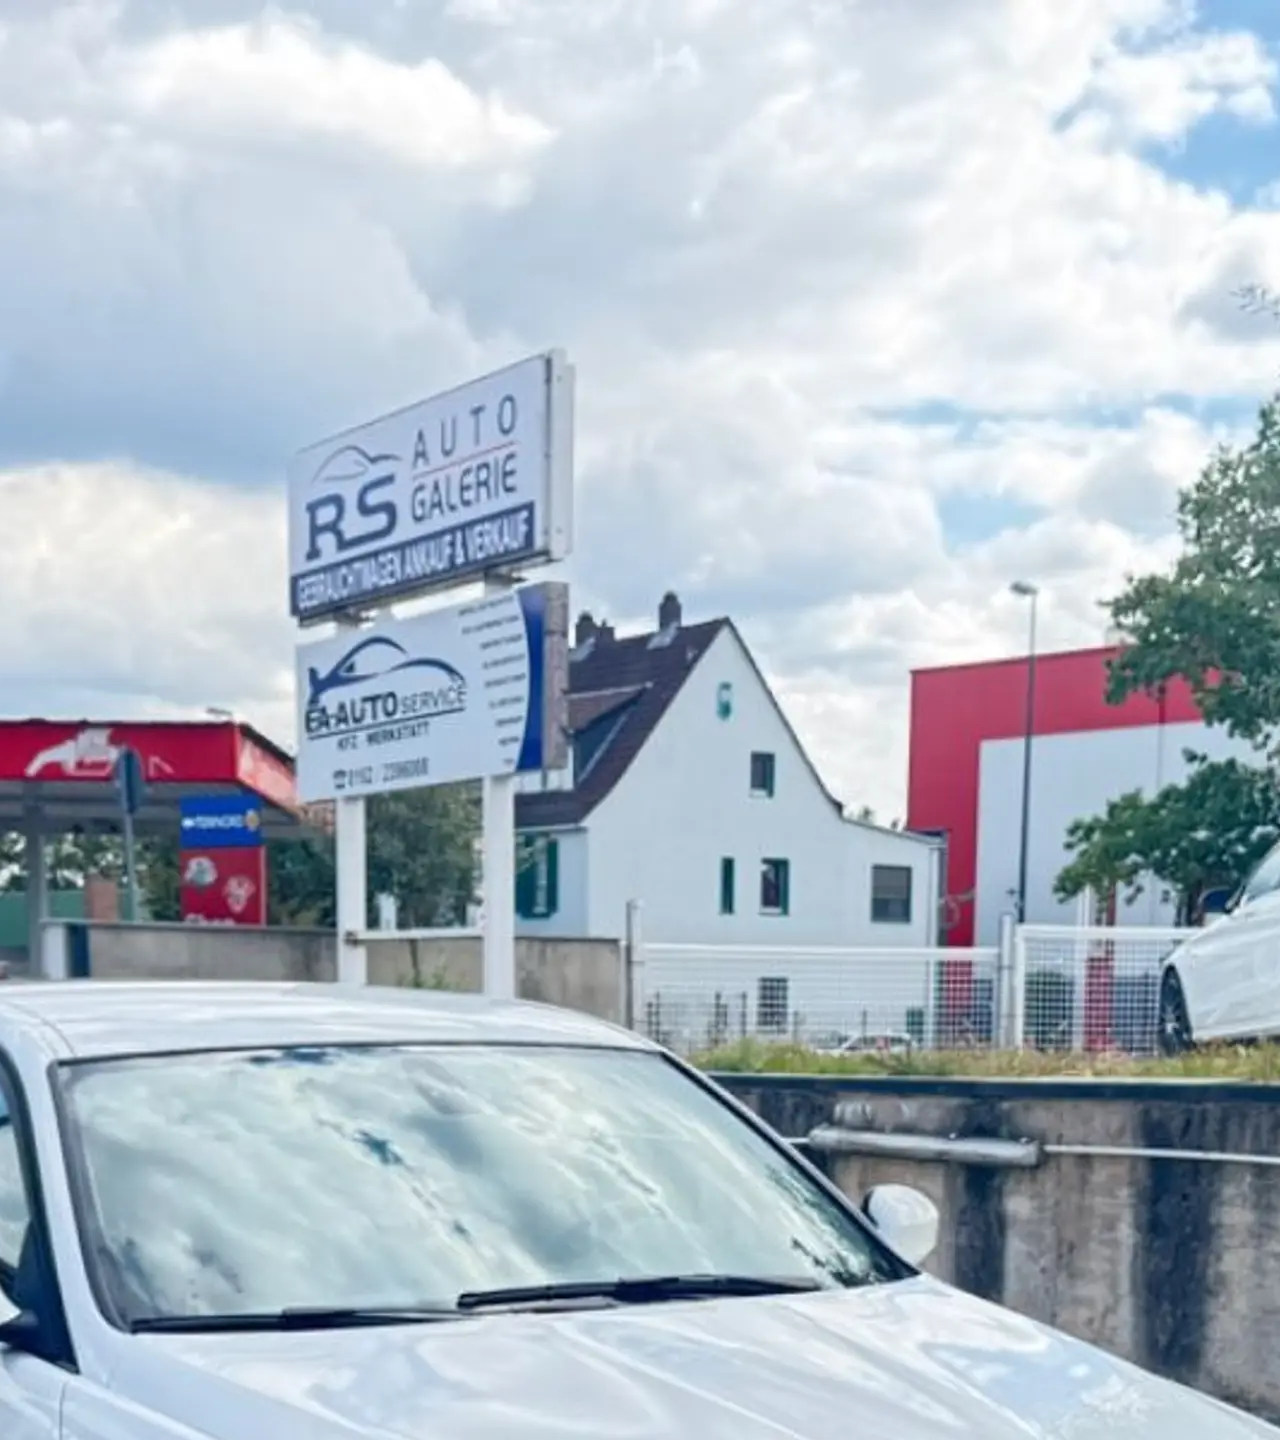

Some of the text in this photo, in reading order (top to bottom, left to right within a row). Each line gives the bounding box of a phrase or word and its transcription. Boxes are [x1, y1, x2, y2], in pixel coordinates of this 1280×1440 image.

[412, 393, 518, 470] AUTO
[305, 473, 398, 562] RS
[410, 451, 518, 523] GALERIE
[402, 529, 453, 583] ANKAUF
[466, 510, 531, 563] VERKAUF
